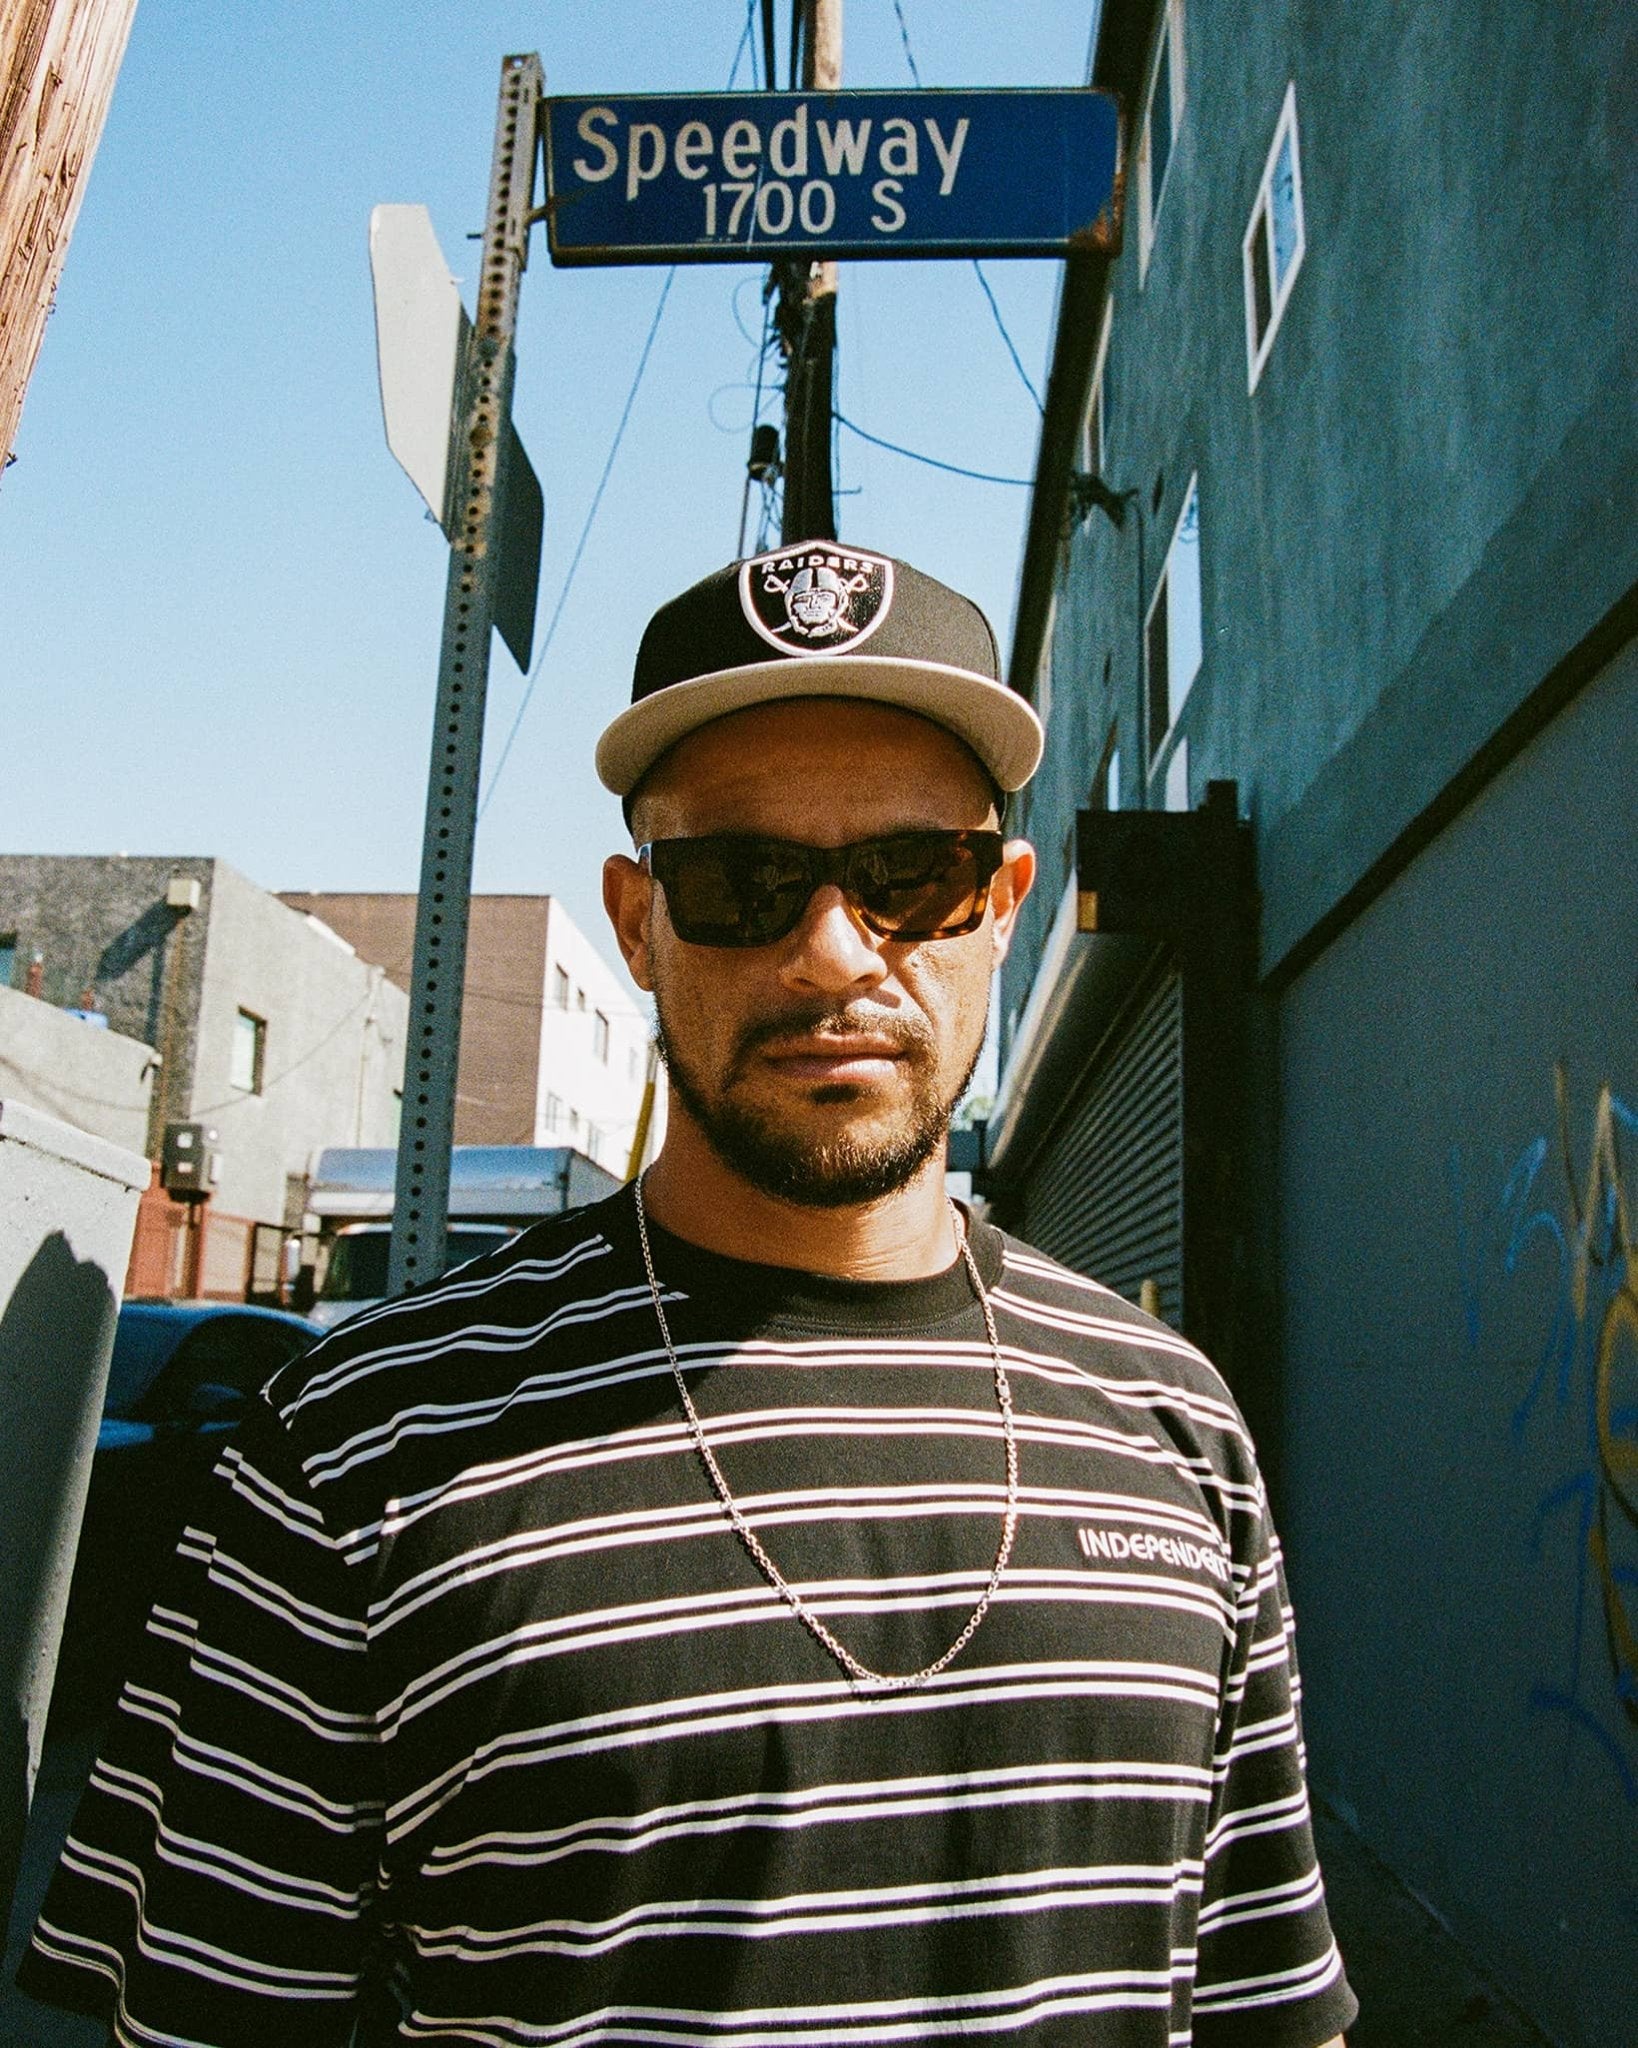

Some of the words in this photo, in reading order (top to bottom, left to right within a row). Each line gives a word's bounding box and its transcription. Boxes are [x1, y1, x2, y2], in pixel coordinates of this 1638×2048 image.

[572, 104, 970, 200] Speedway
[702, 180, 836, 236] 1700
[870, 179, 908, 233] S
[761, 555, 874, 574] RAIDERS
